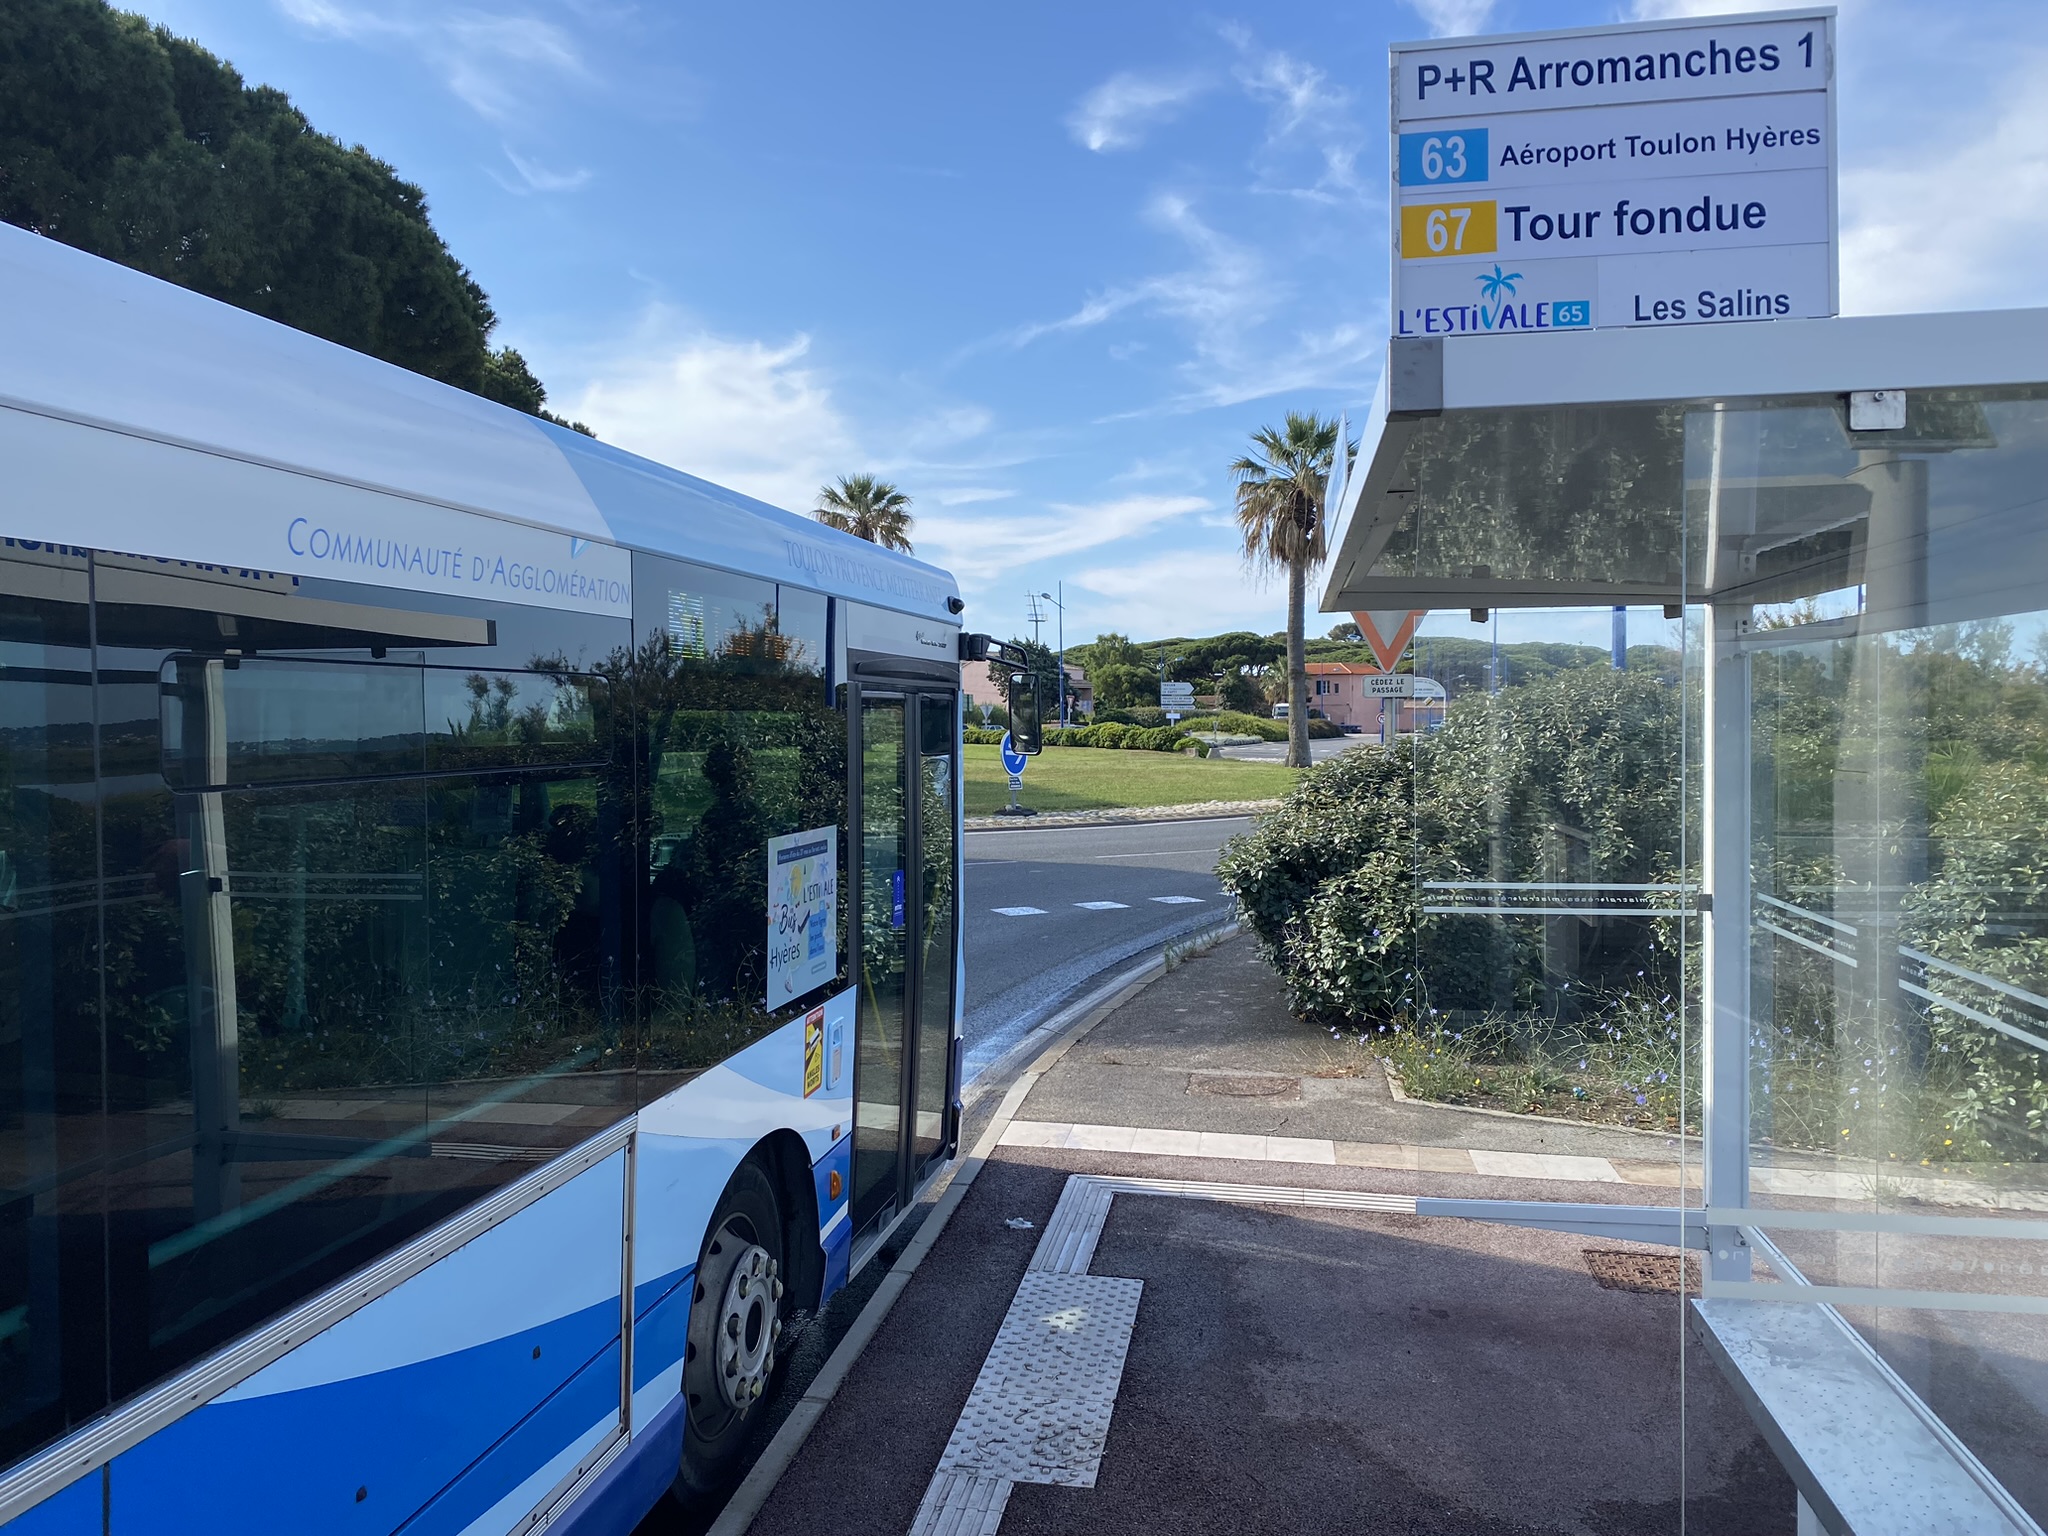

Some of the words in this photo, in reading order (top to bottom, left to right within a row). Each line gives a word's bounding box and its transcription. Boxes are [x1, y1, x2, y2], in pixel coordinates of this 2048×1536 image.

[1417, 59, 1496, 100] P+R
[1507, 38, 1781, 93] Arromanches
[1797, 31, 1815, 68] 1
[1421, 135, 1467, 180] 63
[1500, 137, 1617, 168] Aéroport
[1625, 130, 1717, 159] Toulon
[1726, 125, 1822, 157] Hyères
[1426, 207, 1472, 253] 67
[1504, 205, 1602, 243] Tour
[1613, 195, 1767, 237] fondue
[1558, 304, 1584, 323] 65
[1634, 293, 1686, 323] Les
[1697, 288, 1791, 320] Salins
[783, 539, 834, 577] TOULON
[834, 554, 885, 592] PROVENCE
[1370, 677, 1393, 686] CÉDEZ
[1371, 686, 1404, 694] PASSAGE
[779, 903, 797, 935] Bus
[769, 943, 801, 973] Hyères
